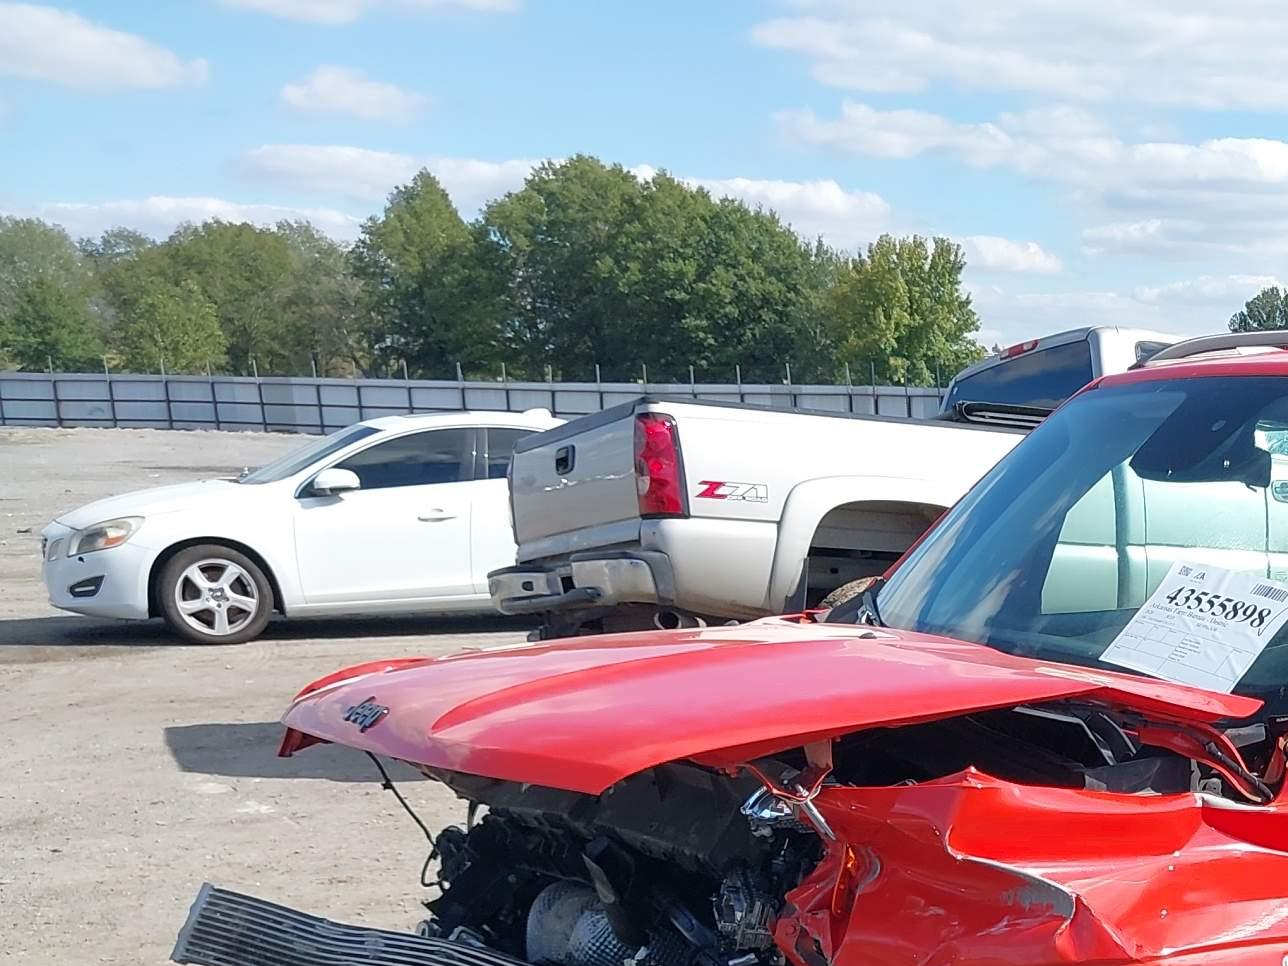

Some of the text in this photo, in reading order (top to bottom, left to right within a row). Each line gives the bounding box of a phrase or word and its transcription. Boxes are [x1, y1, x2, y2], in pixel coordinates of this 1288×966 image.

[695, 480, 768, 499] Z71
[1166, 586, 1272, 628] 43555898
[344, 696, 390, 733] Jeep
